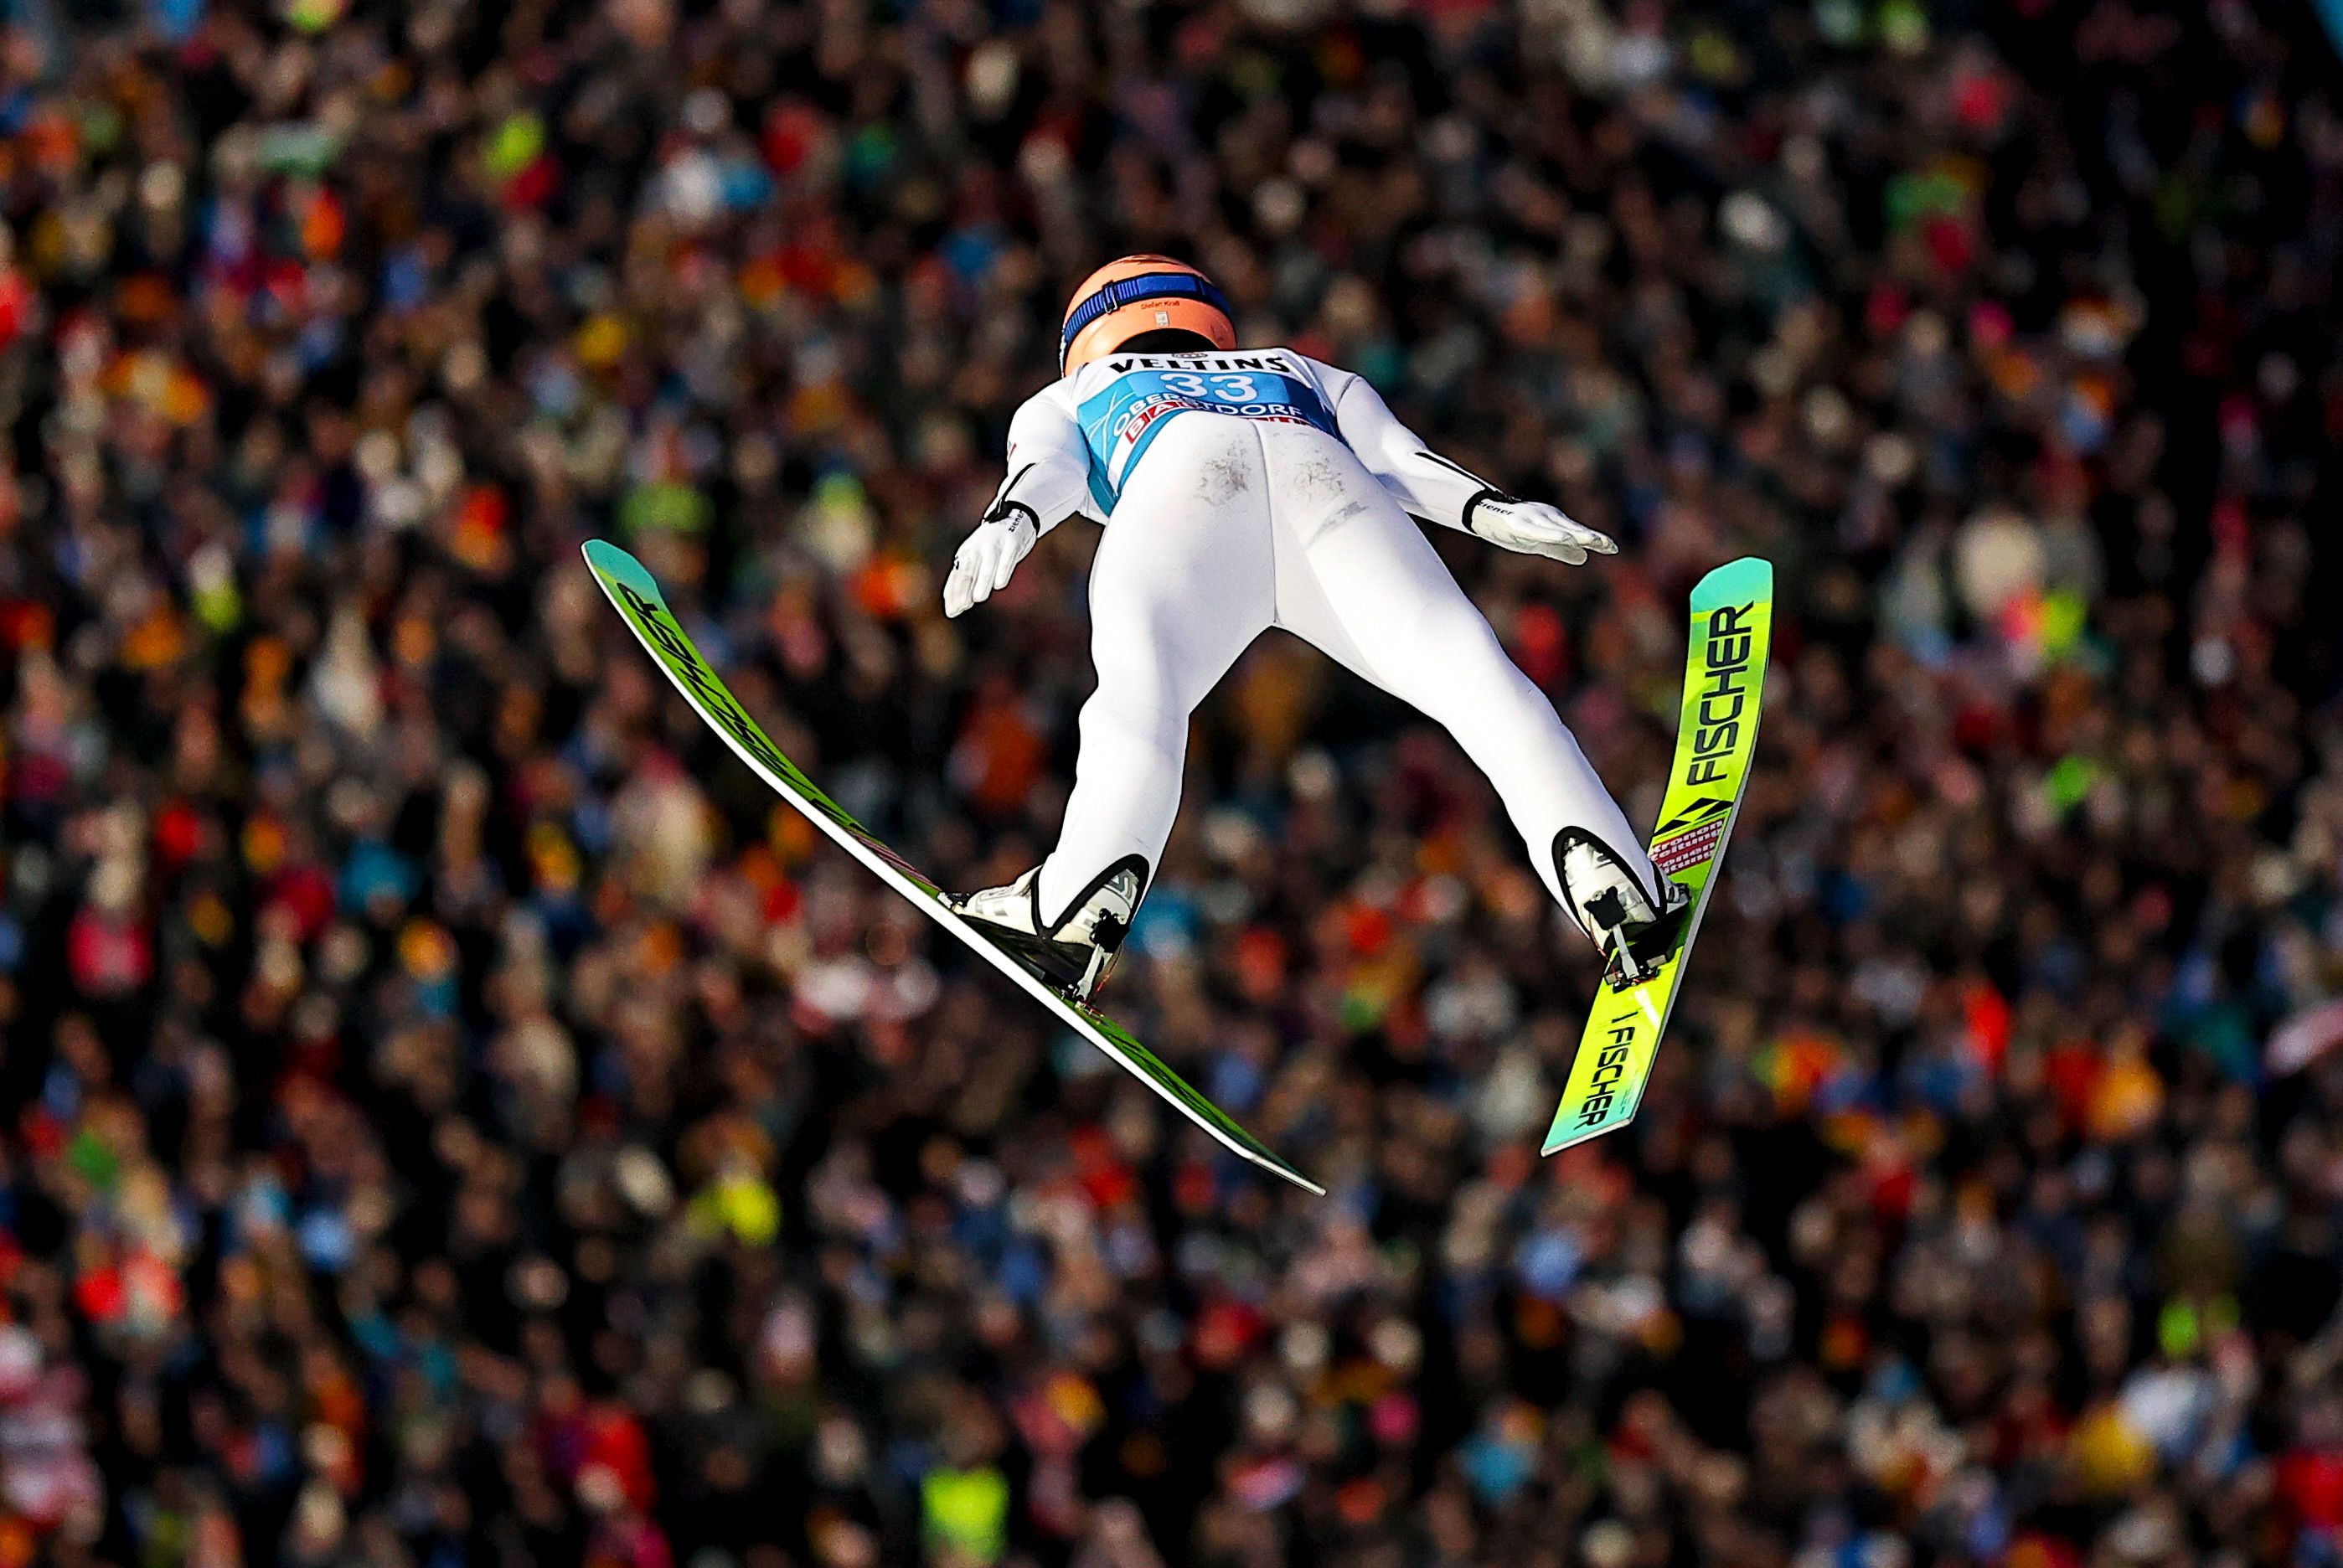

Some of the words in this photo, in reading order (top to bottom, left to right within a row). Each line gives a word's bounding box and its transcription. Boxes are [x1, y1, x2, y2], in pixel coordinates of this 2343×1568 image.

[1109, 357, 1289, 374] VELTINS
[1160, 374, 1257, 402] 33
[1112, 391, 1302, 437] OBERTDORF
[1686, 600, 1754, 786] FISCHER
[1574, 1027, 1635, 1130] FISCHER
